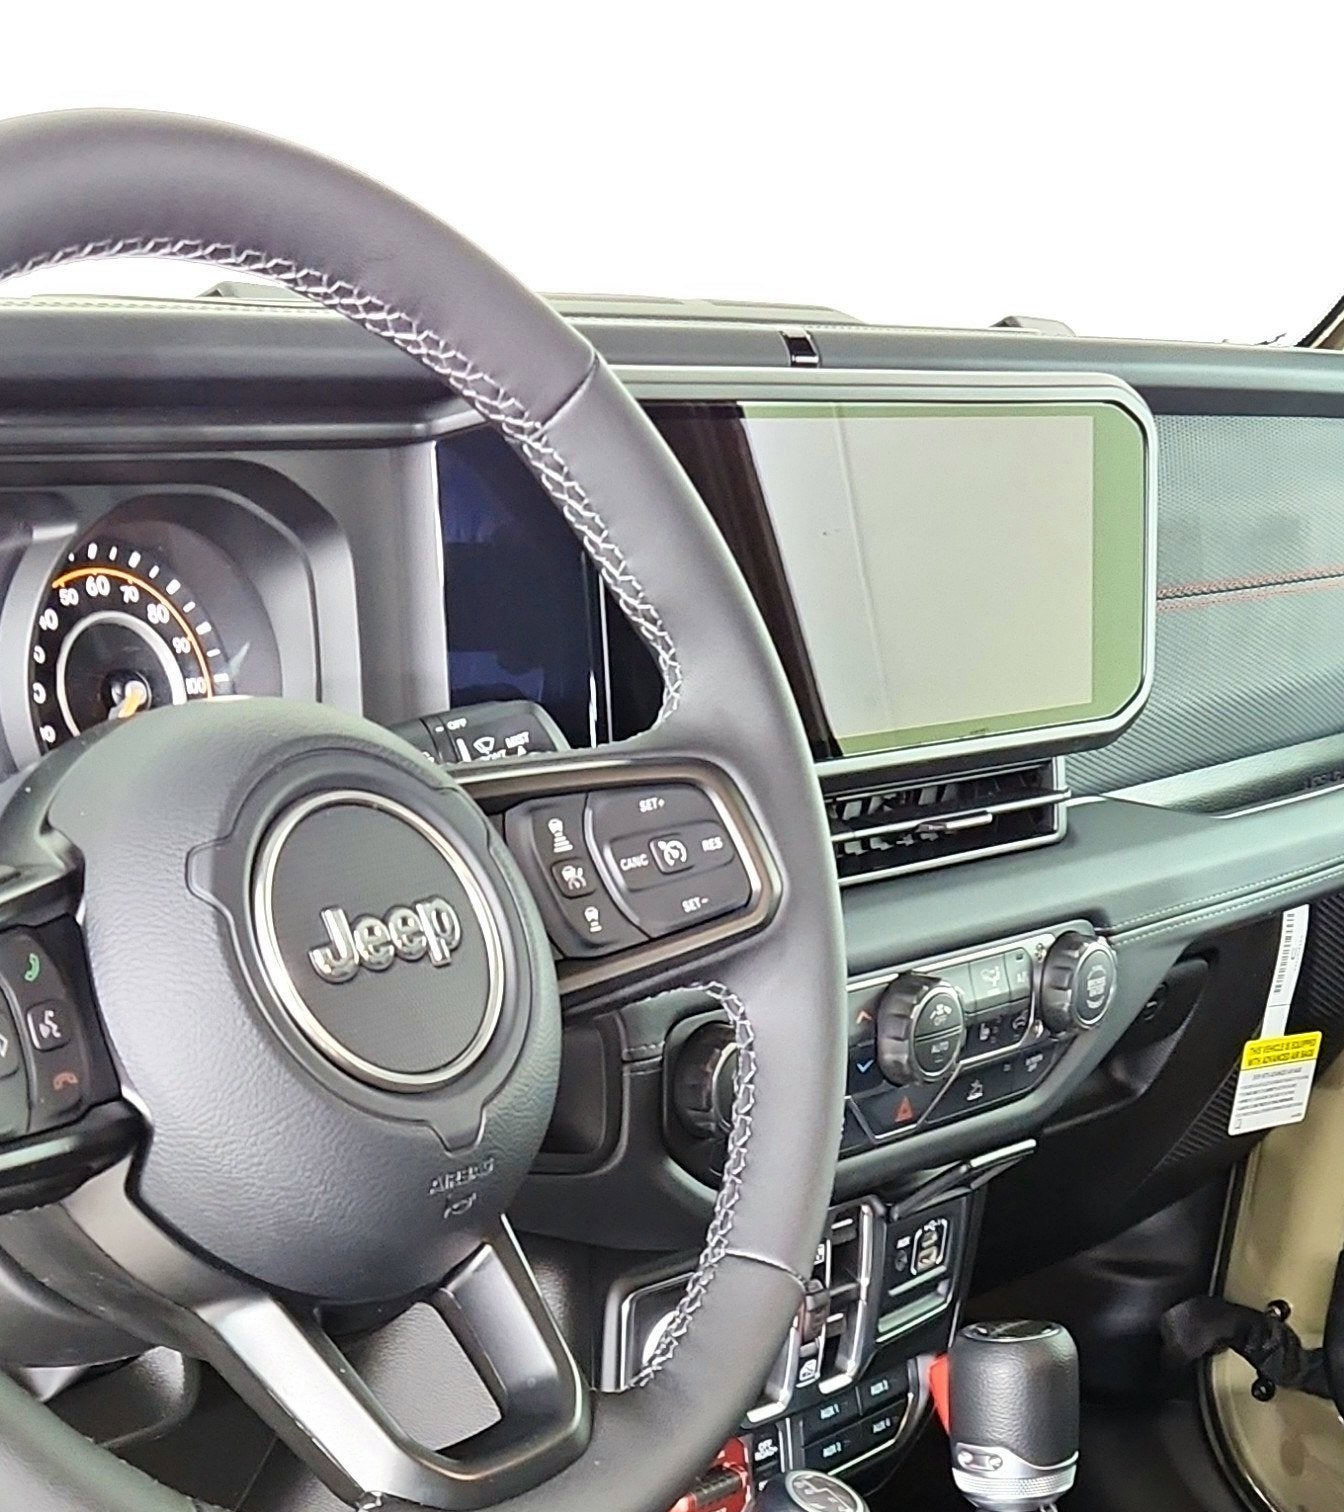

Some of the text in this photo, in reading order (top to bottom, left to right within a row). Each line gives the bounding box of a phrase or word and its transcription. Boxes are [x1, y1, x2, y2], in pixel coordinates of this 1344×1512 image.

[86, 575, 110, 597] 60
[120, 585, 140, 603] 70
[59, 588, 79, 606] 50
[147, 603, 170, 624] 80
[172, 637, 191, 653] 90
[186, 681, 207, 694] 100
[447, 718, 467, 731] OFF
[505, 732, 530, 749] MIST
[619, 836, 724, 871] CANC RES
[308, 895, 462, 984] Jeep
